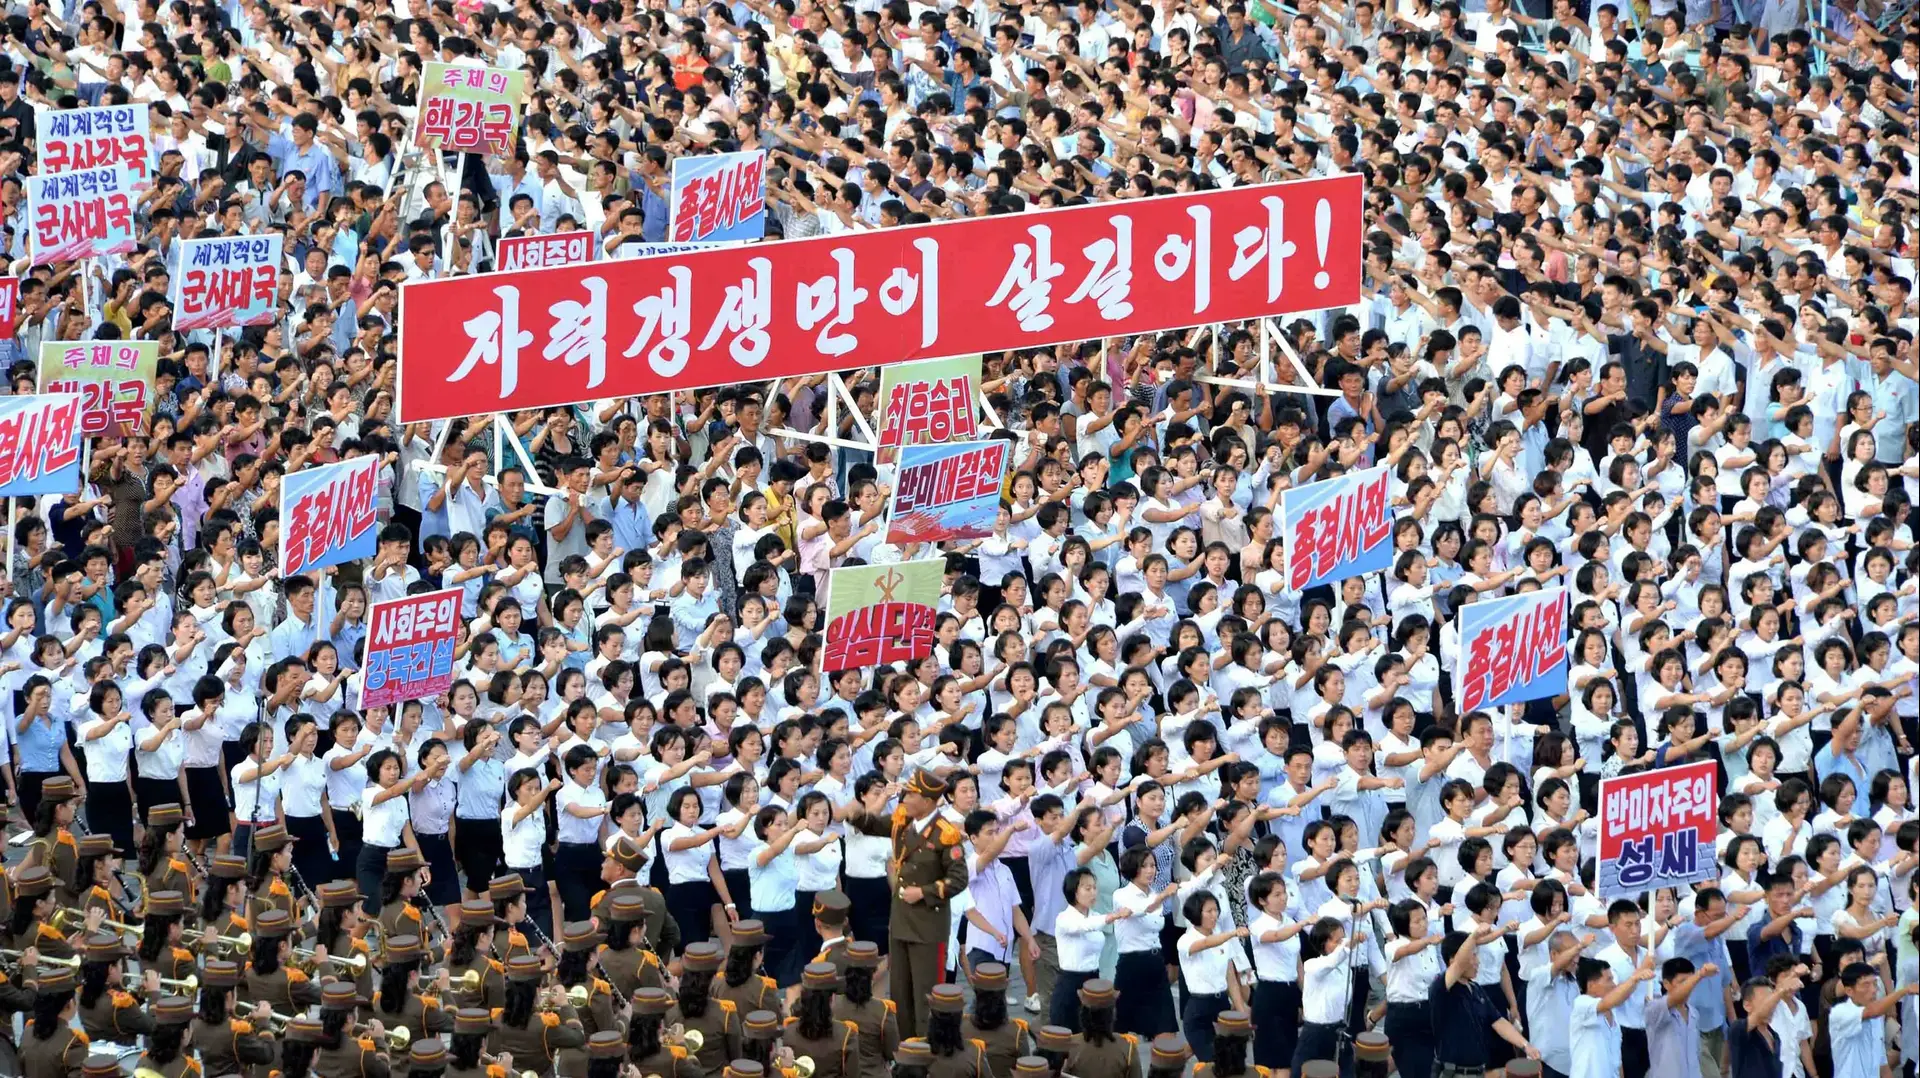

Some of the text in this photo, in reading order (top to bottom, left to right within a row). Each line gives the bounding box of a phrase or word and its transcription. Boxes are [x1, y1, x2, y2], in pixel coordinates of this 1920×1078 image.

[443, 69, 508, 94] 주체의
[50, 108, 135, 137] 세계적인
[426, 97, 513, 151] 핵강국
[41, 168, 118, 200] 세계적인
[675, 154, 764, 242] 총결사전
[35, 193, 132, 247] 군사대국
[192, 239, 270, 266] 세계적인
[504, 236, 587, 271] 사회주의
[183, 265, 277, 314] 군사대국
[444, 195, 1332, 398] 자력갱생만이 살길이다!
[63, 345, 140, 371] 주체의
[879, 375, 978, 448] 최후승리
[894, 443, 1006, 514] 반미대결전
[285, 458, 378, 577] 총결사전
[1290, 470, 1390, 591] 총결사전
[374, 596, 457, 645] 사회주의
[822, 602, 937, 672] 일심단결
[366, 636, 455, 690] 강국건설
[1462, 589, 1566, 714] 총결사전
[1606, 772, 1712, 838] 반미자주의
[1616, 826, 1699, 887] 성새
